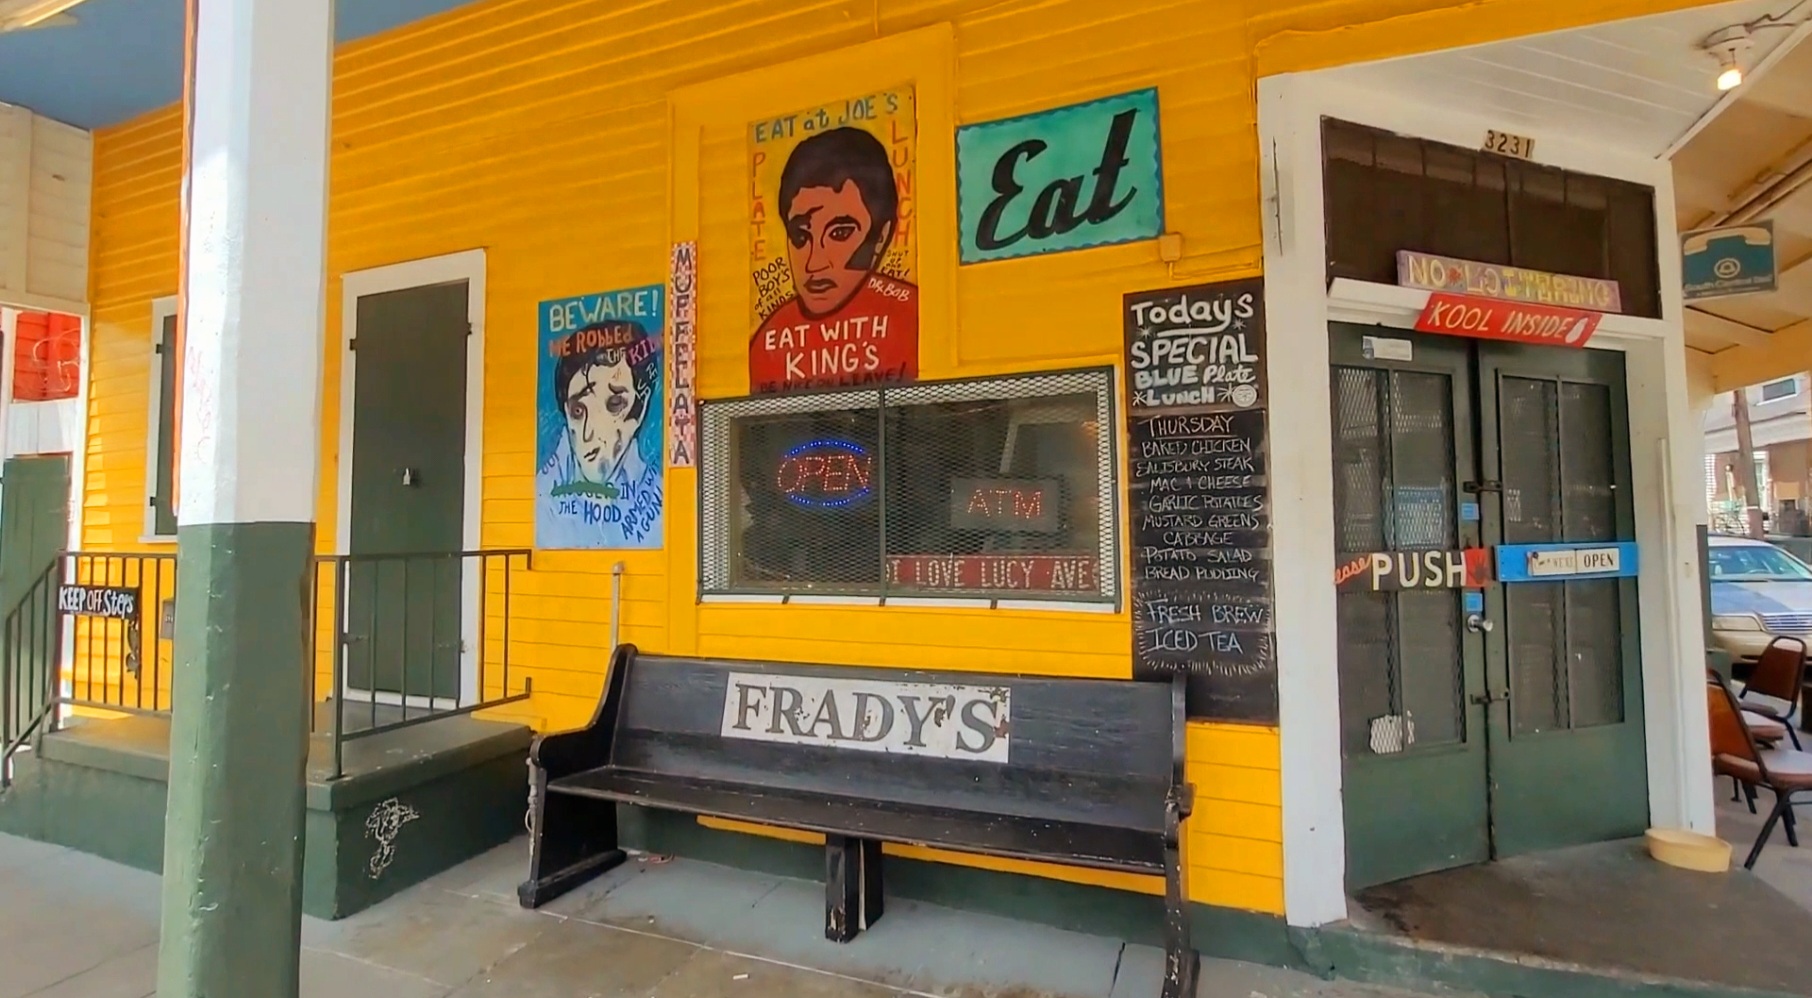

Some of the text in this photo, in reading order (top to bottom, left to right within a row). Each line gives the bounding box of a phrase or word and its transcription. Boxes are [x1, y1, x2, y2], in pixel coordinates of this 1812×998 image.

[755, 114, 798, 143] EAT
[803, 108, 829, 131] at
[1485, 129, 1531, 158] 3231
[891, 119, 914, 249] LUNCH
[975, 107, 1138, 251] Eat
[751, 152, 766, 262] PLATE
[752, 256, 787, 287] POOR
[758, 267, 790, 298] BOY'S
[1408, 254, 1447, 286] NO
[550, 290, 659, 332] BEWARE!
[758, 290, 794, 320] KINDS
[1130, 293, 1254, 337] Todays
[1427, 300, 1574, 338] KOOL INSIDE
[765, 315, 889, 351] EAT WITH
[786, 341, 880, 381] KING'S
[1131, 333, 1258, 369] SPECIAL
[1134, 363, 1256, 390] BLUE Plate
[1145, 386, 1215, 407] LUNCH
[1138, 414, 1235, 437] THURSDAY
[1141, 437, 1251, 458] BAKED CHICKEN
[777, 454, 872, 493] OPEN
[1135, 456, 1255, 478] SALISBURY STEAK
[620, 480, 636, 500] IN
[1150, 477, 1181, 494] MAC
[1197, 475, 1252, 490] CHEESE
[558, 500, 622, 525] THE HOOD
[621, 490, 651, 539] ARMED
[967, 489, 1042, 519] ATM
[1148, 495, 1198, 513] GARLIC
[1142, 513, 1260, 531] MUSTARD GREENS
[1162, 531, 1234, 546] CABBAGE
[1141, 546, 1253, 564] POTATO SALAD
[1583, 553, 1614, 568] OPEN
[915, 560, 965, 587] LOVE
[981, 560, 1035, 588] LUCY
[1145, 566, 1259, 582] BREAD PUDDING
[1334, 550, 1467, 591] ease PUSH
[59, 586, 134, 619] KEEP OFF Steps
[1145, 598, 1264, 624] FRESH BREW
[1145, 627, 1244, 655] ICED TEA
[731, 682, 998, 753] FRADY'S
